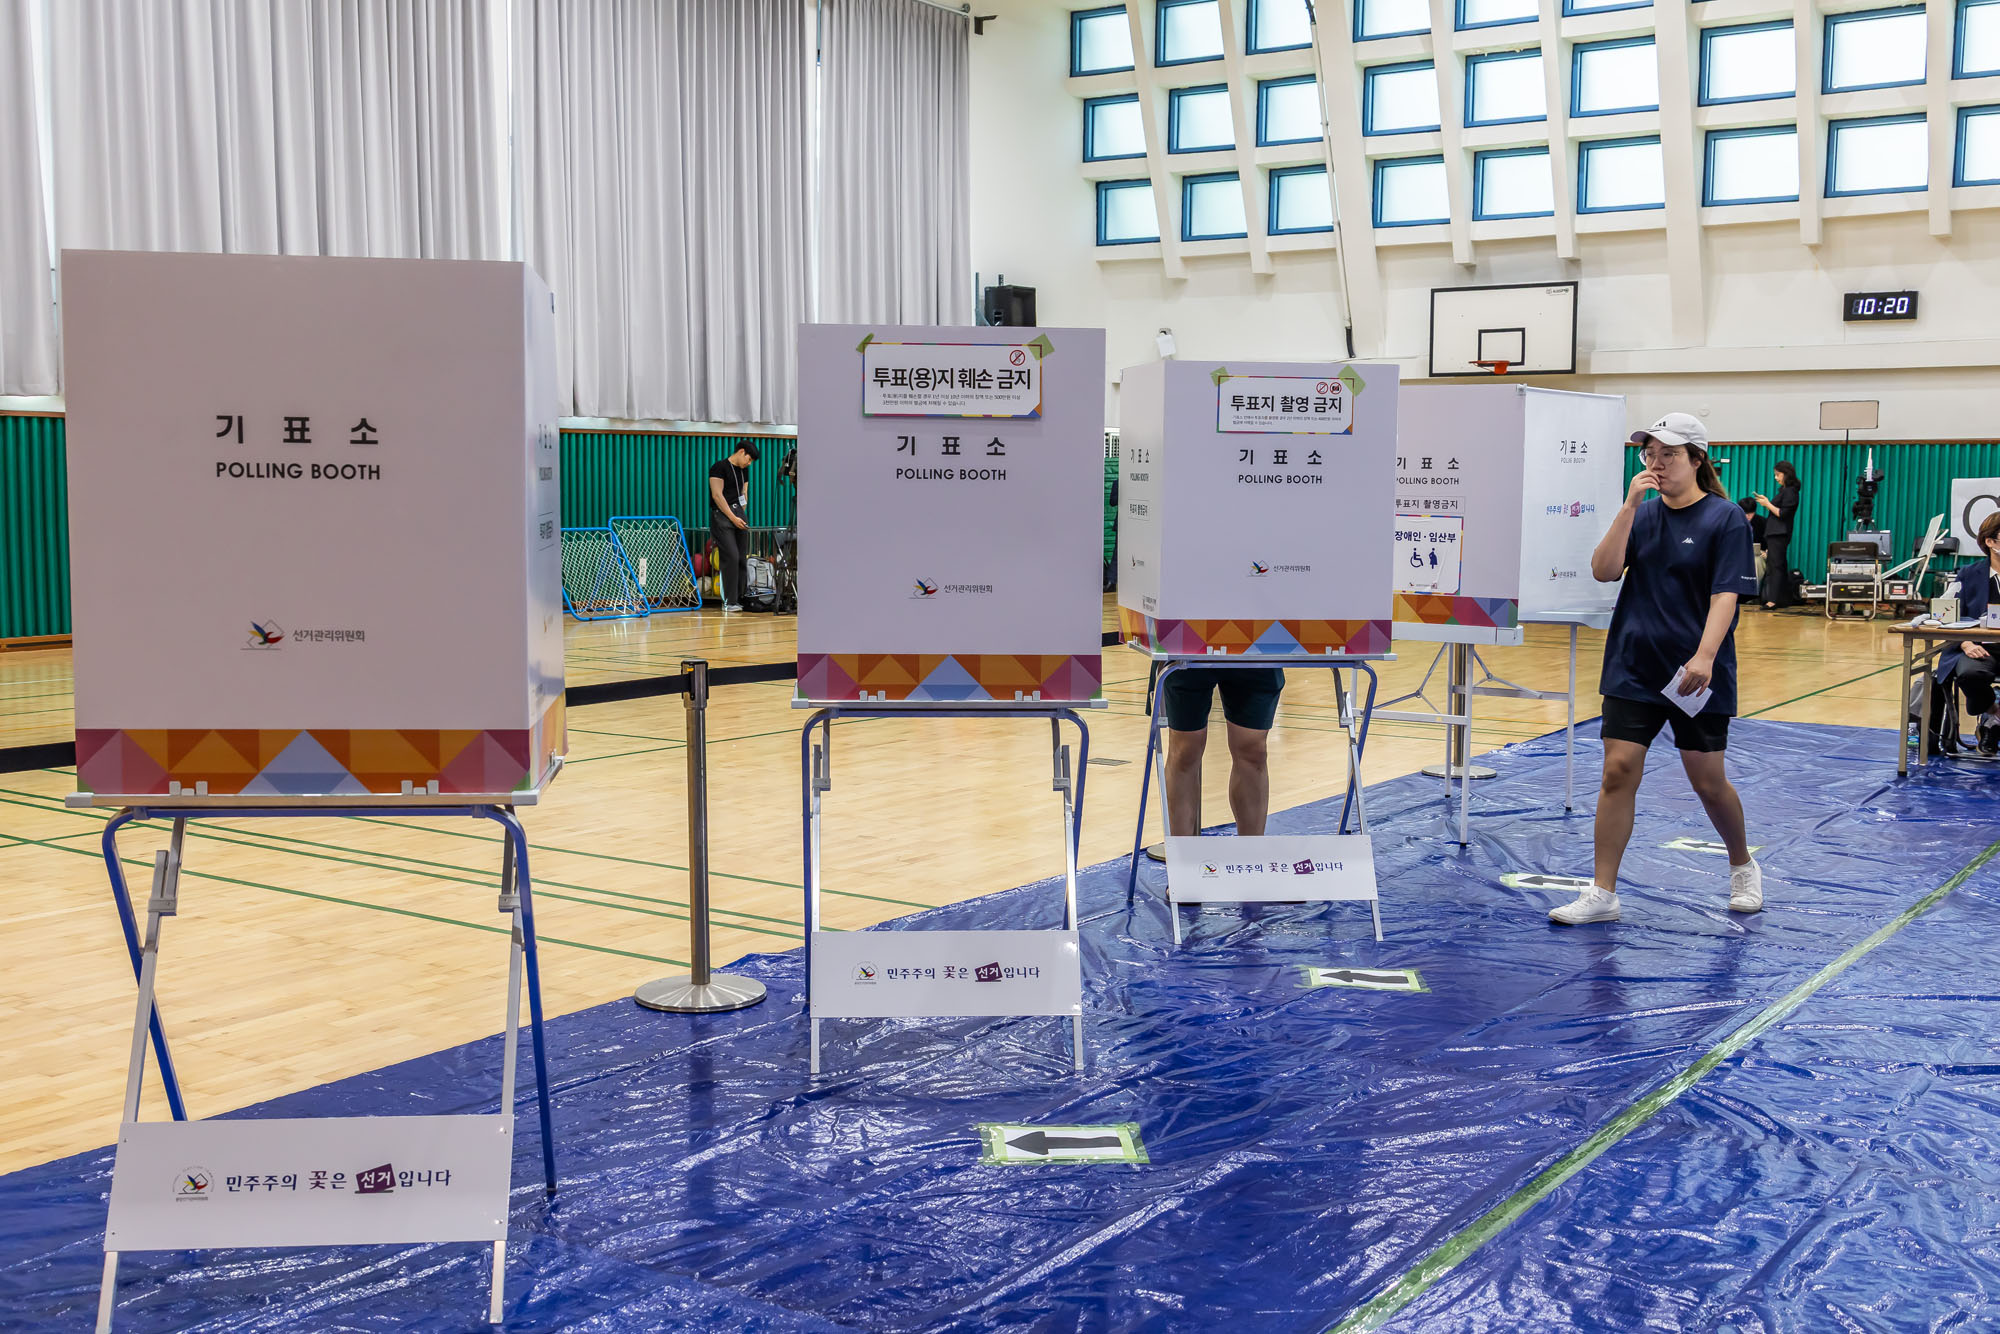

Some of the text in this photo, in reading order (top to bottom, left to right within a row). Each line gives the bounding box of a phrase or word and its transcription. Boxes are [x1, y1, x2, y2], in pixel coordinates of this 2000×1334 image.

[1857, 297, 1909, 315] 10:20
[872, 366, 1032, 390] 투표(용)지 훼손 금지
[1229, 394, 1343, 414] 투표지 촬영 금지
[215, 461, 381, 481] POLLING BOOTH
[895, 468, 1007, 481] POLLING BOOTH
[1237, 474, 1323, 485] POLLING BOOTH
[1396, 476, 1460, 486] OLLING BOOTH
[1423, 499, 1459, 510] 촬영금지
[1394, 530, 1422, 542] 장애인
[1429, 531, 1457, 544] 임산부
[1273, 563, 1311, 574] 선거관리위원회
[942, 583, 994, 594] 선거관리위원회
[292, 628, 366, 643] 선거관리위원회
[1225, 863, 1264, 874] 민주주의
[1268, 862, 1289, 873] 꽃은
[886, 966, 936, 980] 민주주의
[942, 965, 970, 979] 꽃은
[225, 1173, 298, 1193] 민주주의
[307, 1170, 348, 1191] 꽃은
